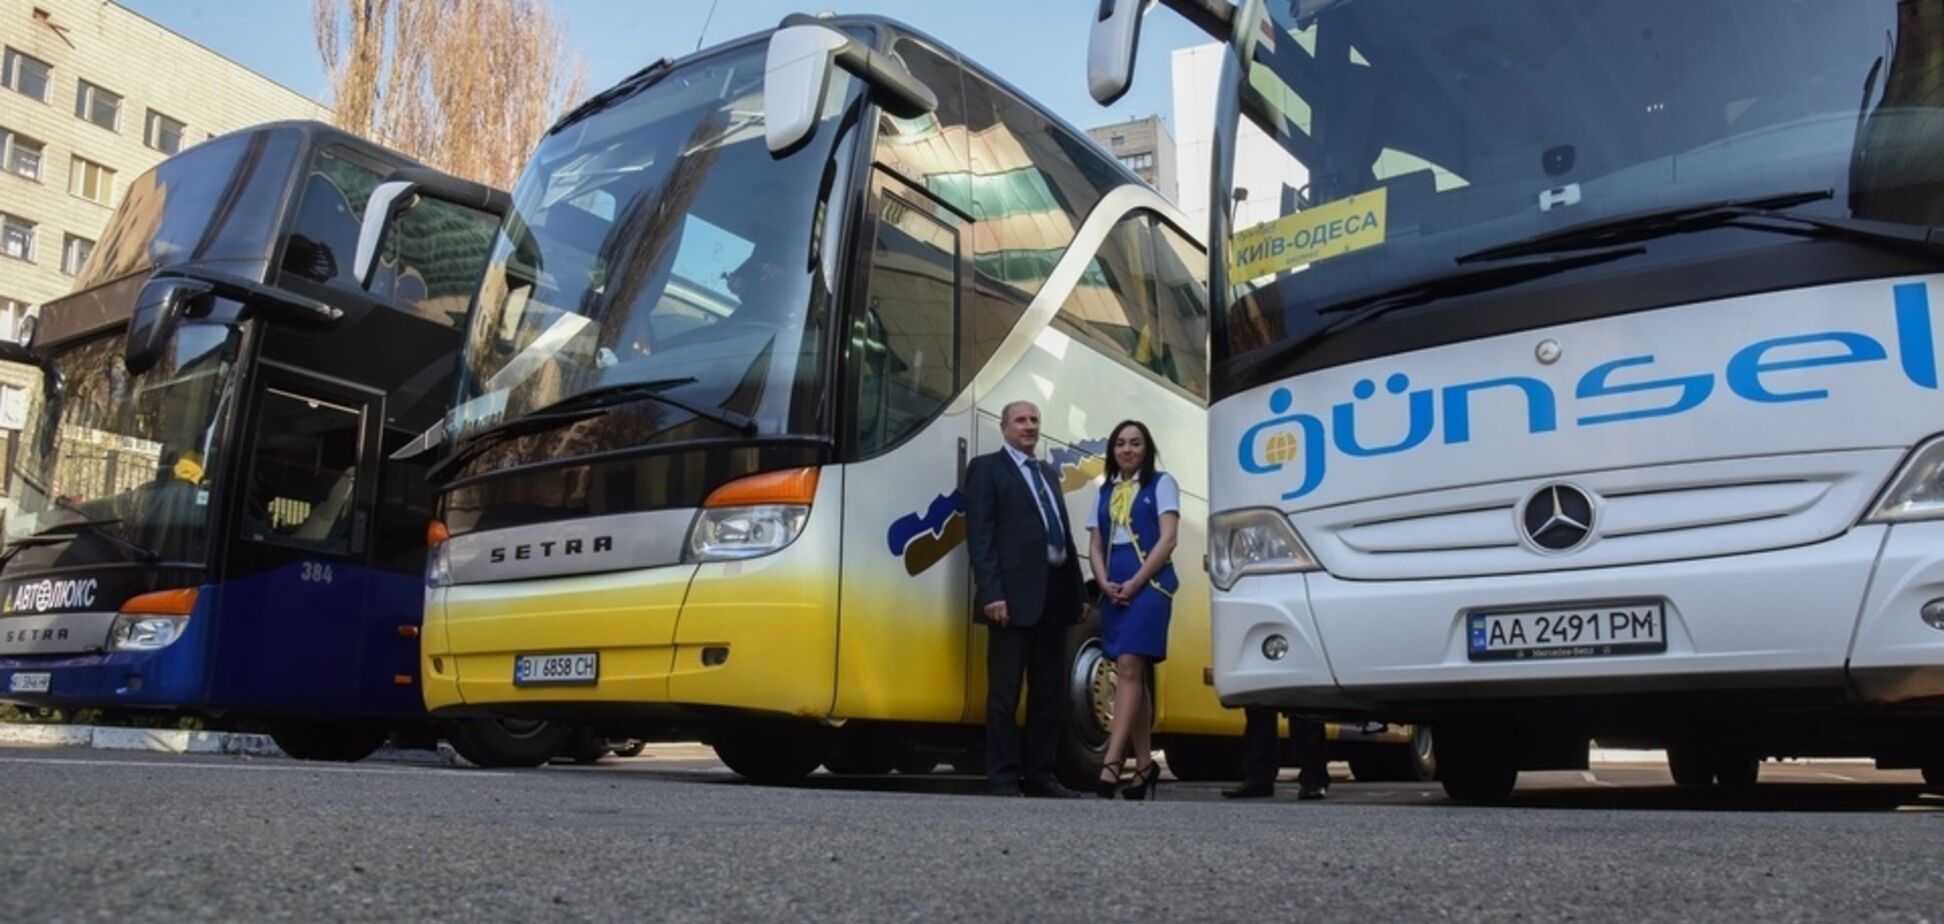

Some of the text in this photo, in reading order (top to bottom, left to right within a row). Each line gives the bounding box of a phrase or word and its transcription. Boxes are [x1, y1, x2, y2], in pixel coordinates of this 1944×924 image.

[1236, 211, 1378, 267] КИЇВ-ОДЕСА
[490, 535, 613, 563] SETRA
[301, 561, 333, 584] 384
[6, 628, 69, 642] SETRA
[1489, 610, 1653, 646] AA 2491 PM
[543, 657, 572, 677] 6858
